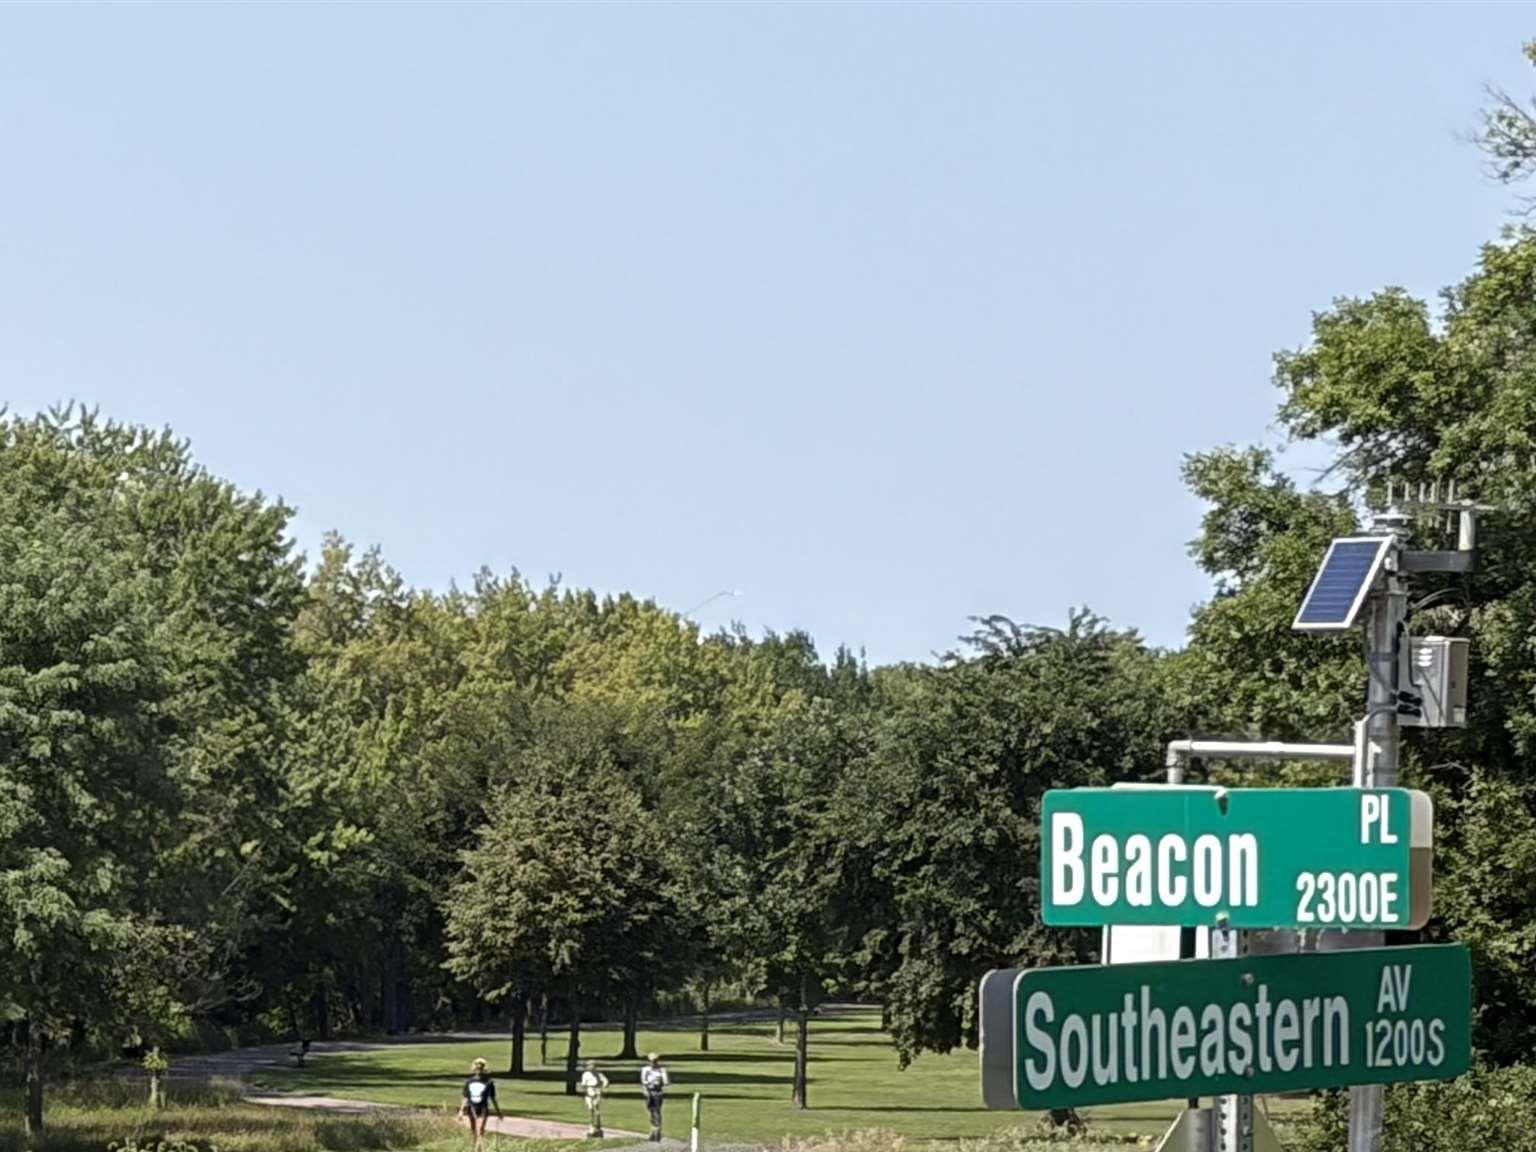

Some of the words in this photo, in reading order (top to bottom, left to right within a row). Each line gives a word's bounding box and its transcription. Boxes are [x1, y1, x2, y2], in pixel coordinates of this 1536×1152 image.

[1361, 793, 1398, 844] PL
[1050, 811, 1259, 908] Beacon
[1296, 872, 1399, 924] 2300E
[1377, 964, 1413, 1013] AV
[1024, 984, 1350, 1091] Southeastern
[1365, 1017, 1446, 1070] 1200S
